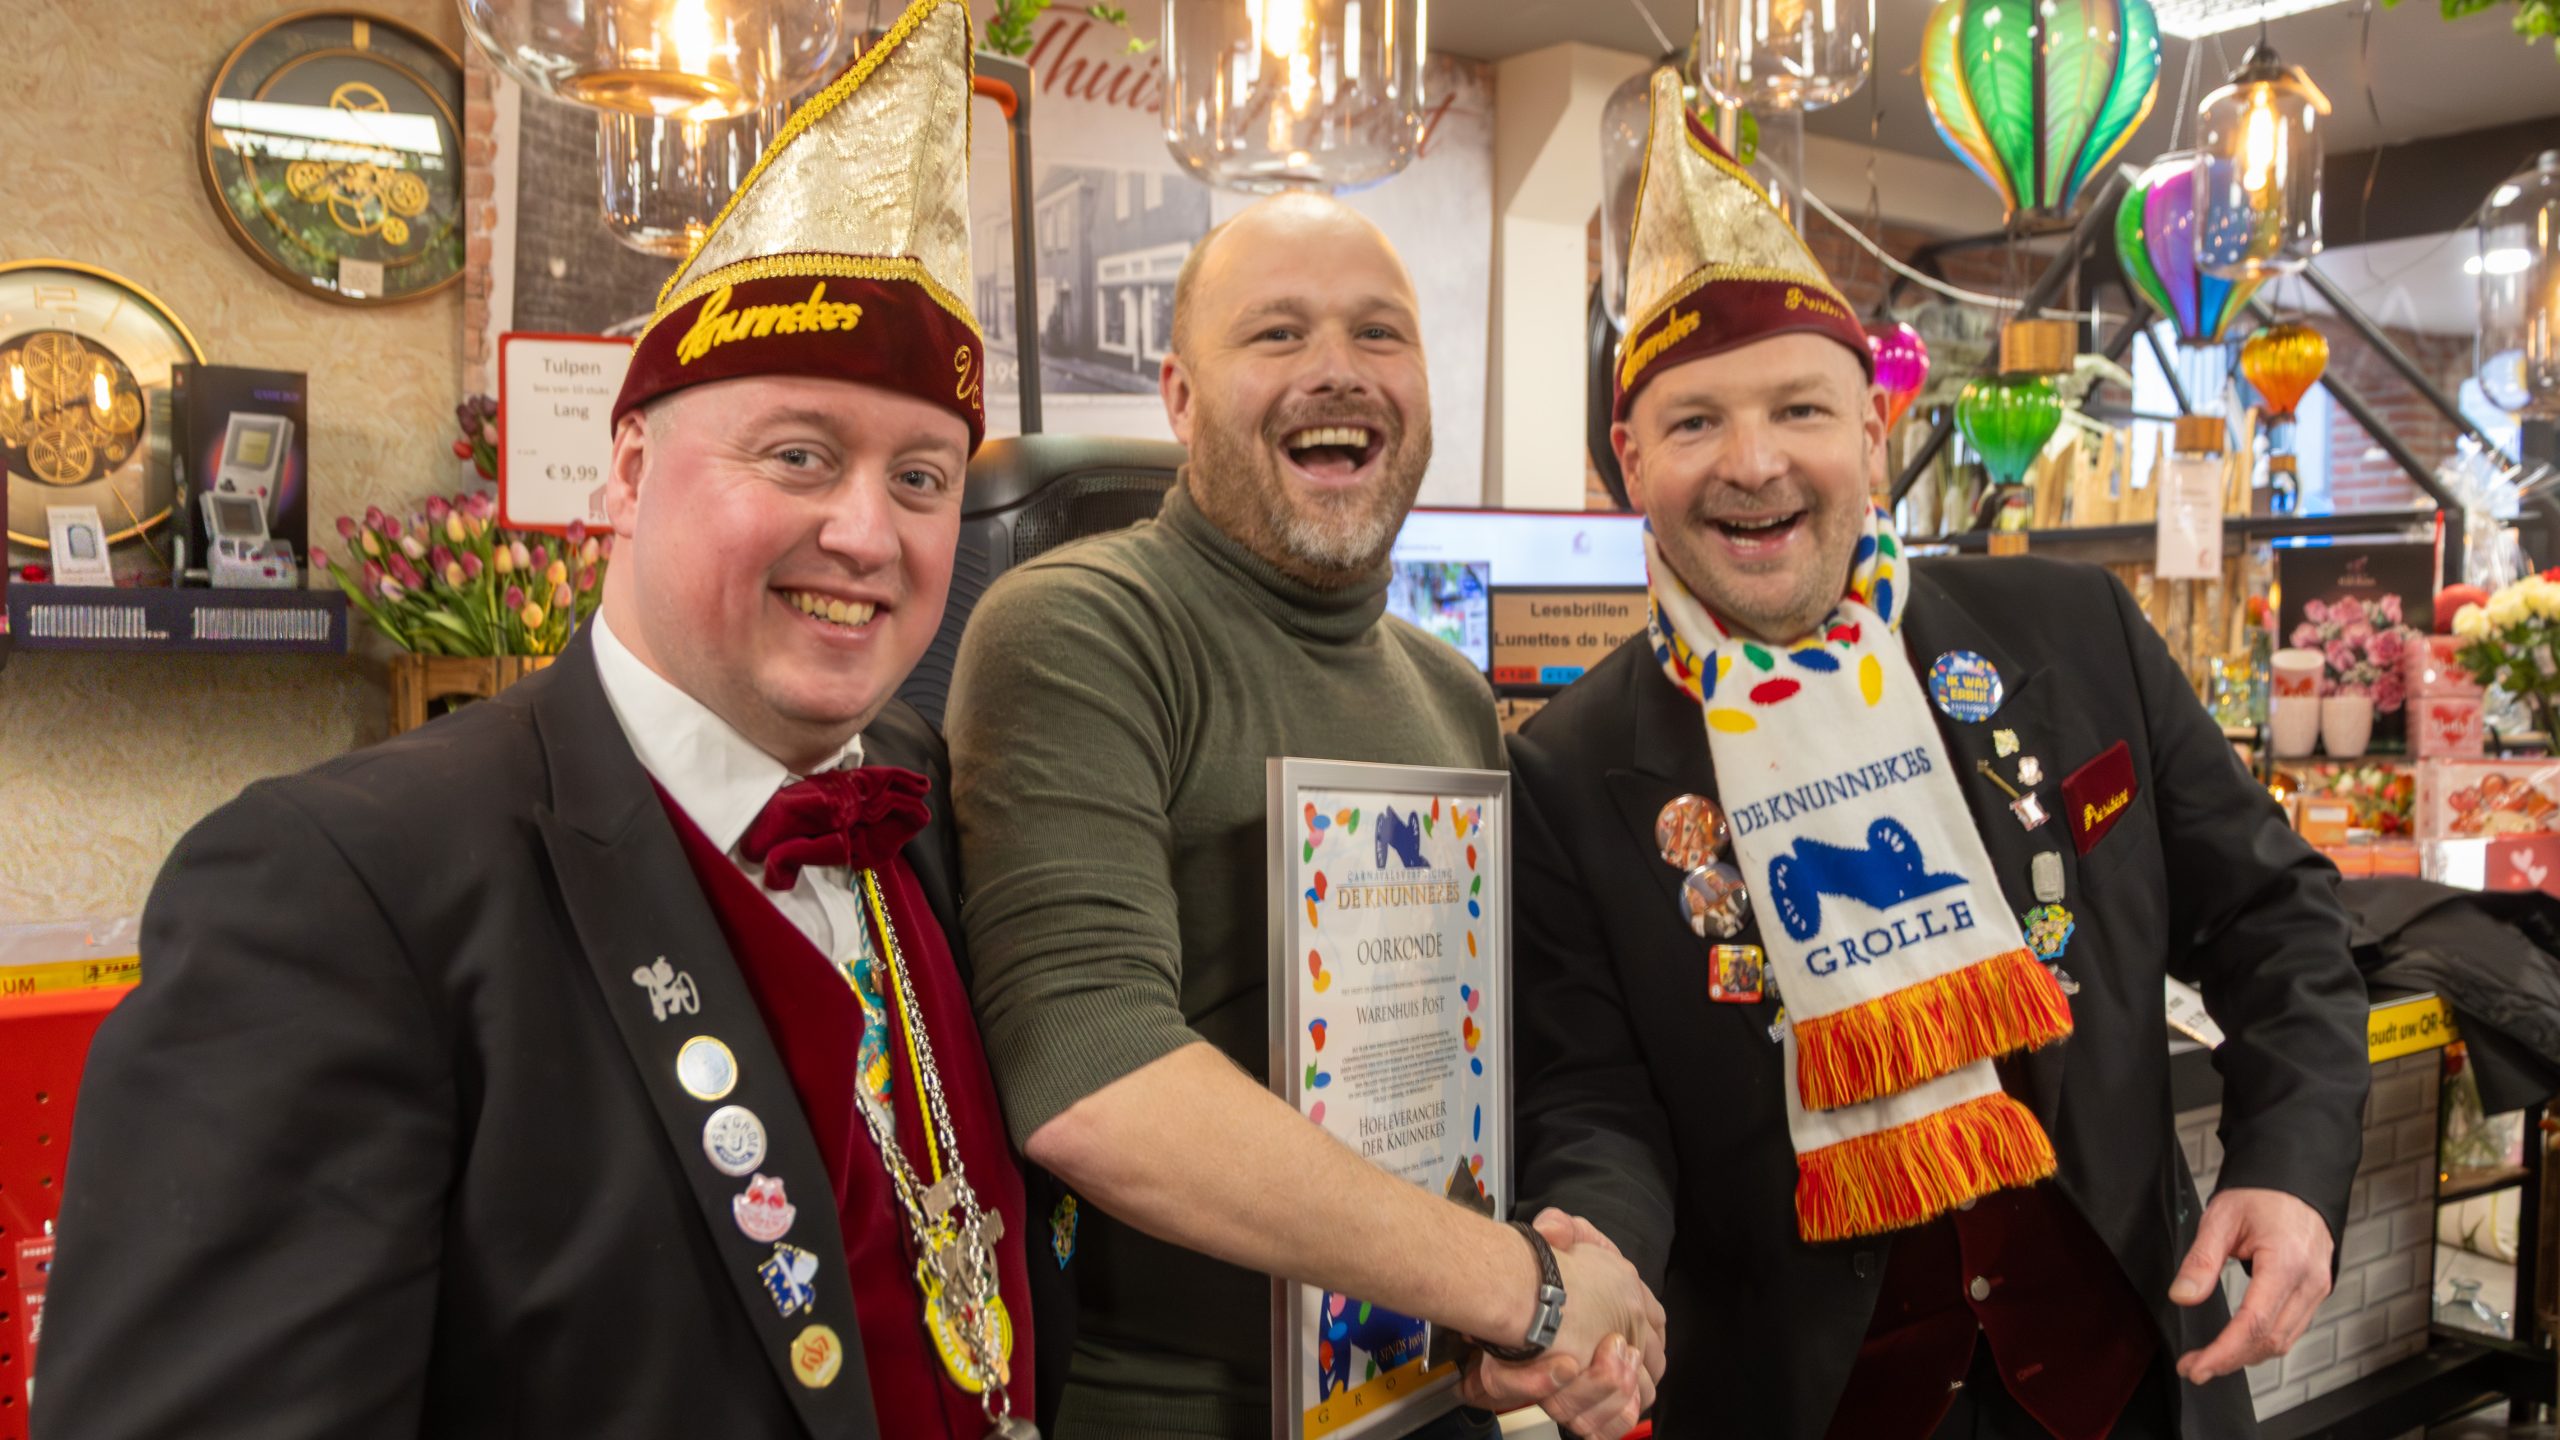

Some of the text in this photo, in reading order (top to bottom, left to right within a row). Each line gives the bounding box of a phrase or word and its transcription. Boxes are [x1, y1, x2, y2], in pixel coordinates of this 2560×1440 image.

[543, 358, 602, 377] Tulpen
[553, 402, 590, 421] Lang
[545, 465, 599, 483] € 9,99
[1530, 602, 1629, 618] Leesbrillen
[1494, 632, 1571, 648] Lunettes
[1576, 632, 1598, 648] de
[1962, 674, 1990, 691] WAS
[1337, 881, 1460, 911] DE KNUNNEKES
[1356, 932, 1444, 967] OORKONDE
[1804, 901, 1976, 977] GROLLE
[1356, 994, 1446, 1026] WARENHUIS POST
[1358, 1100, 1448, 1138] HOFLEVERANCIER
[1362, 1121, 1447, 1159] DER KNUNNEKES
